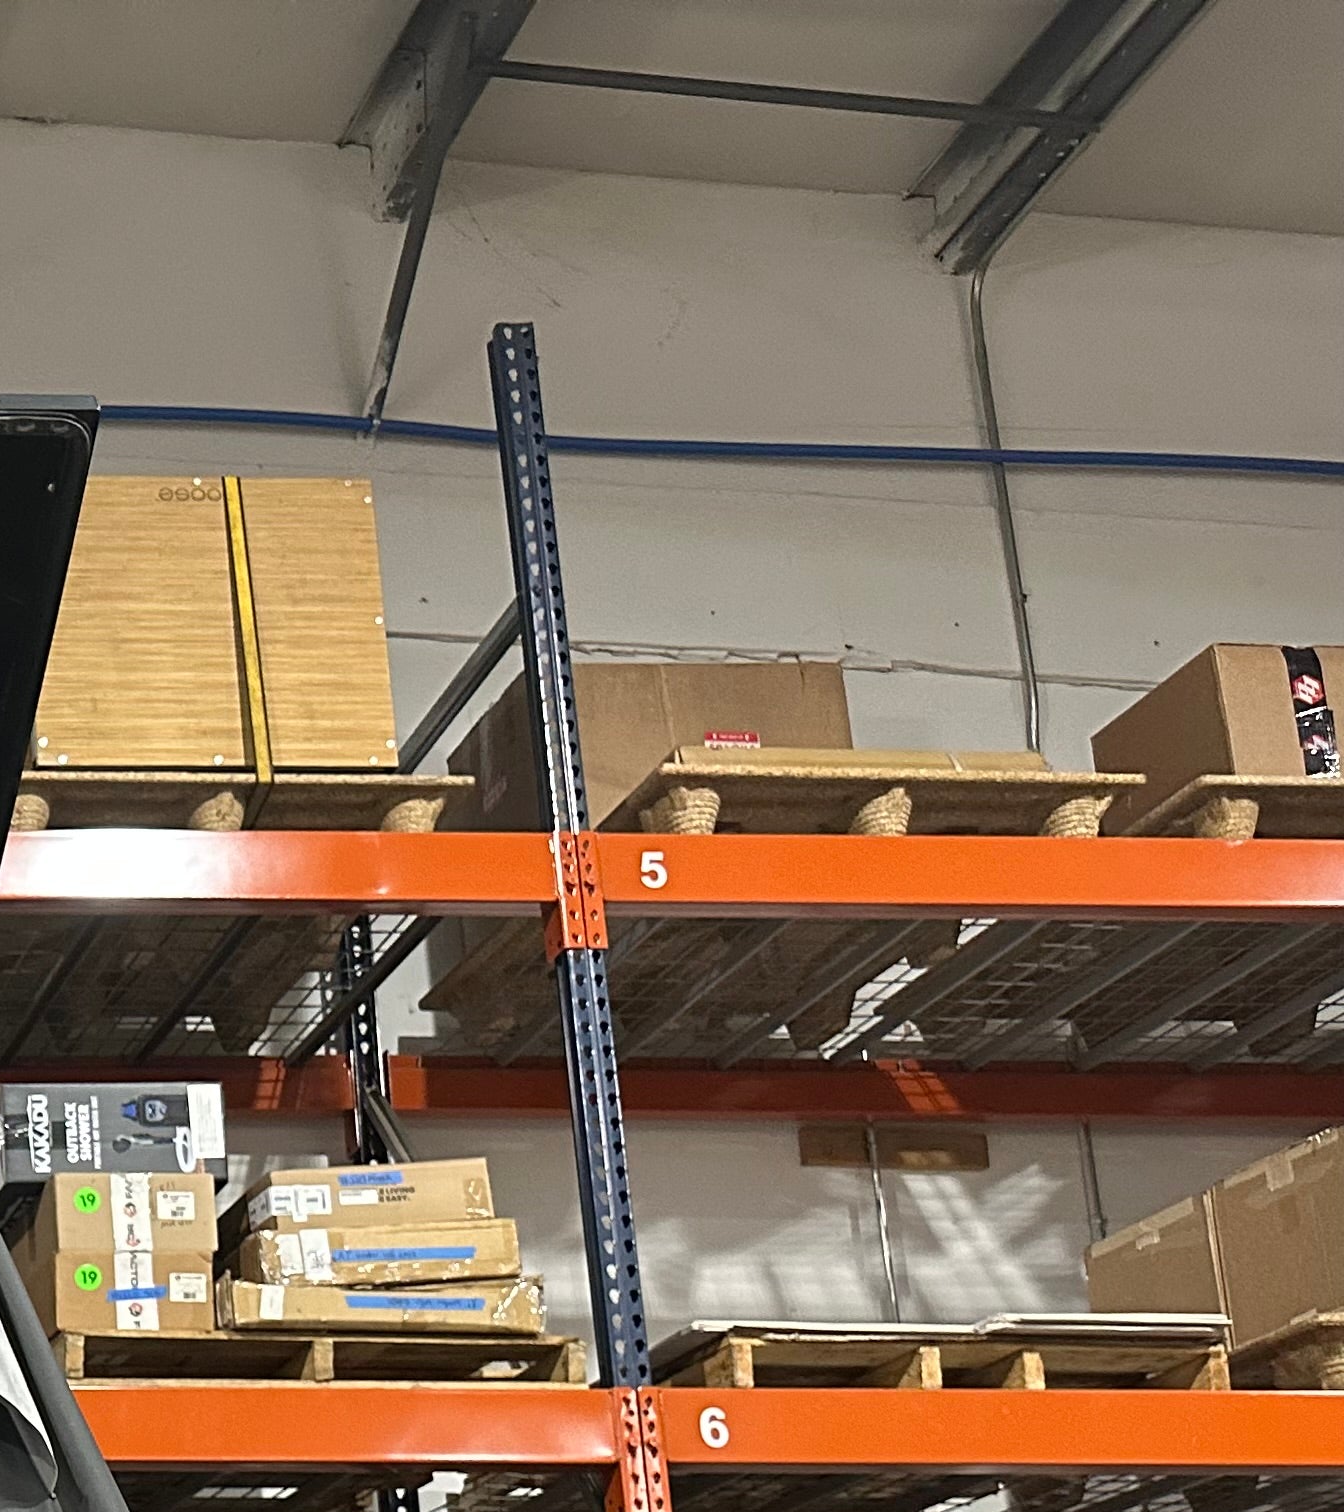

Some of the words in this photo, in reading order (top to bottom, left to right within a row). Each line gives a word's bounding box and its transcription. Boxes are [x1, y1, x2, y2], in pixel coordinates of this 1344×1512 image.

[639, 850, 668, 889] 5
[28, 1094, 51, 1173] KAKADU
[64, 1102, 79, 1163] OUTBACK
[79, 1193, 97, 1207] 19
[80, 1270, 98, 1285] 19
[699, 1407, 730, 1448] 6
